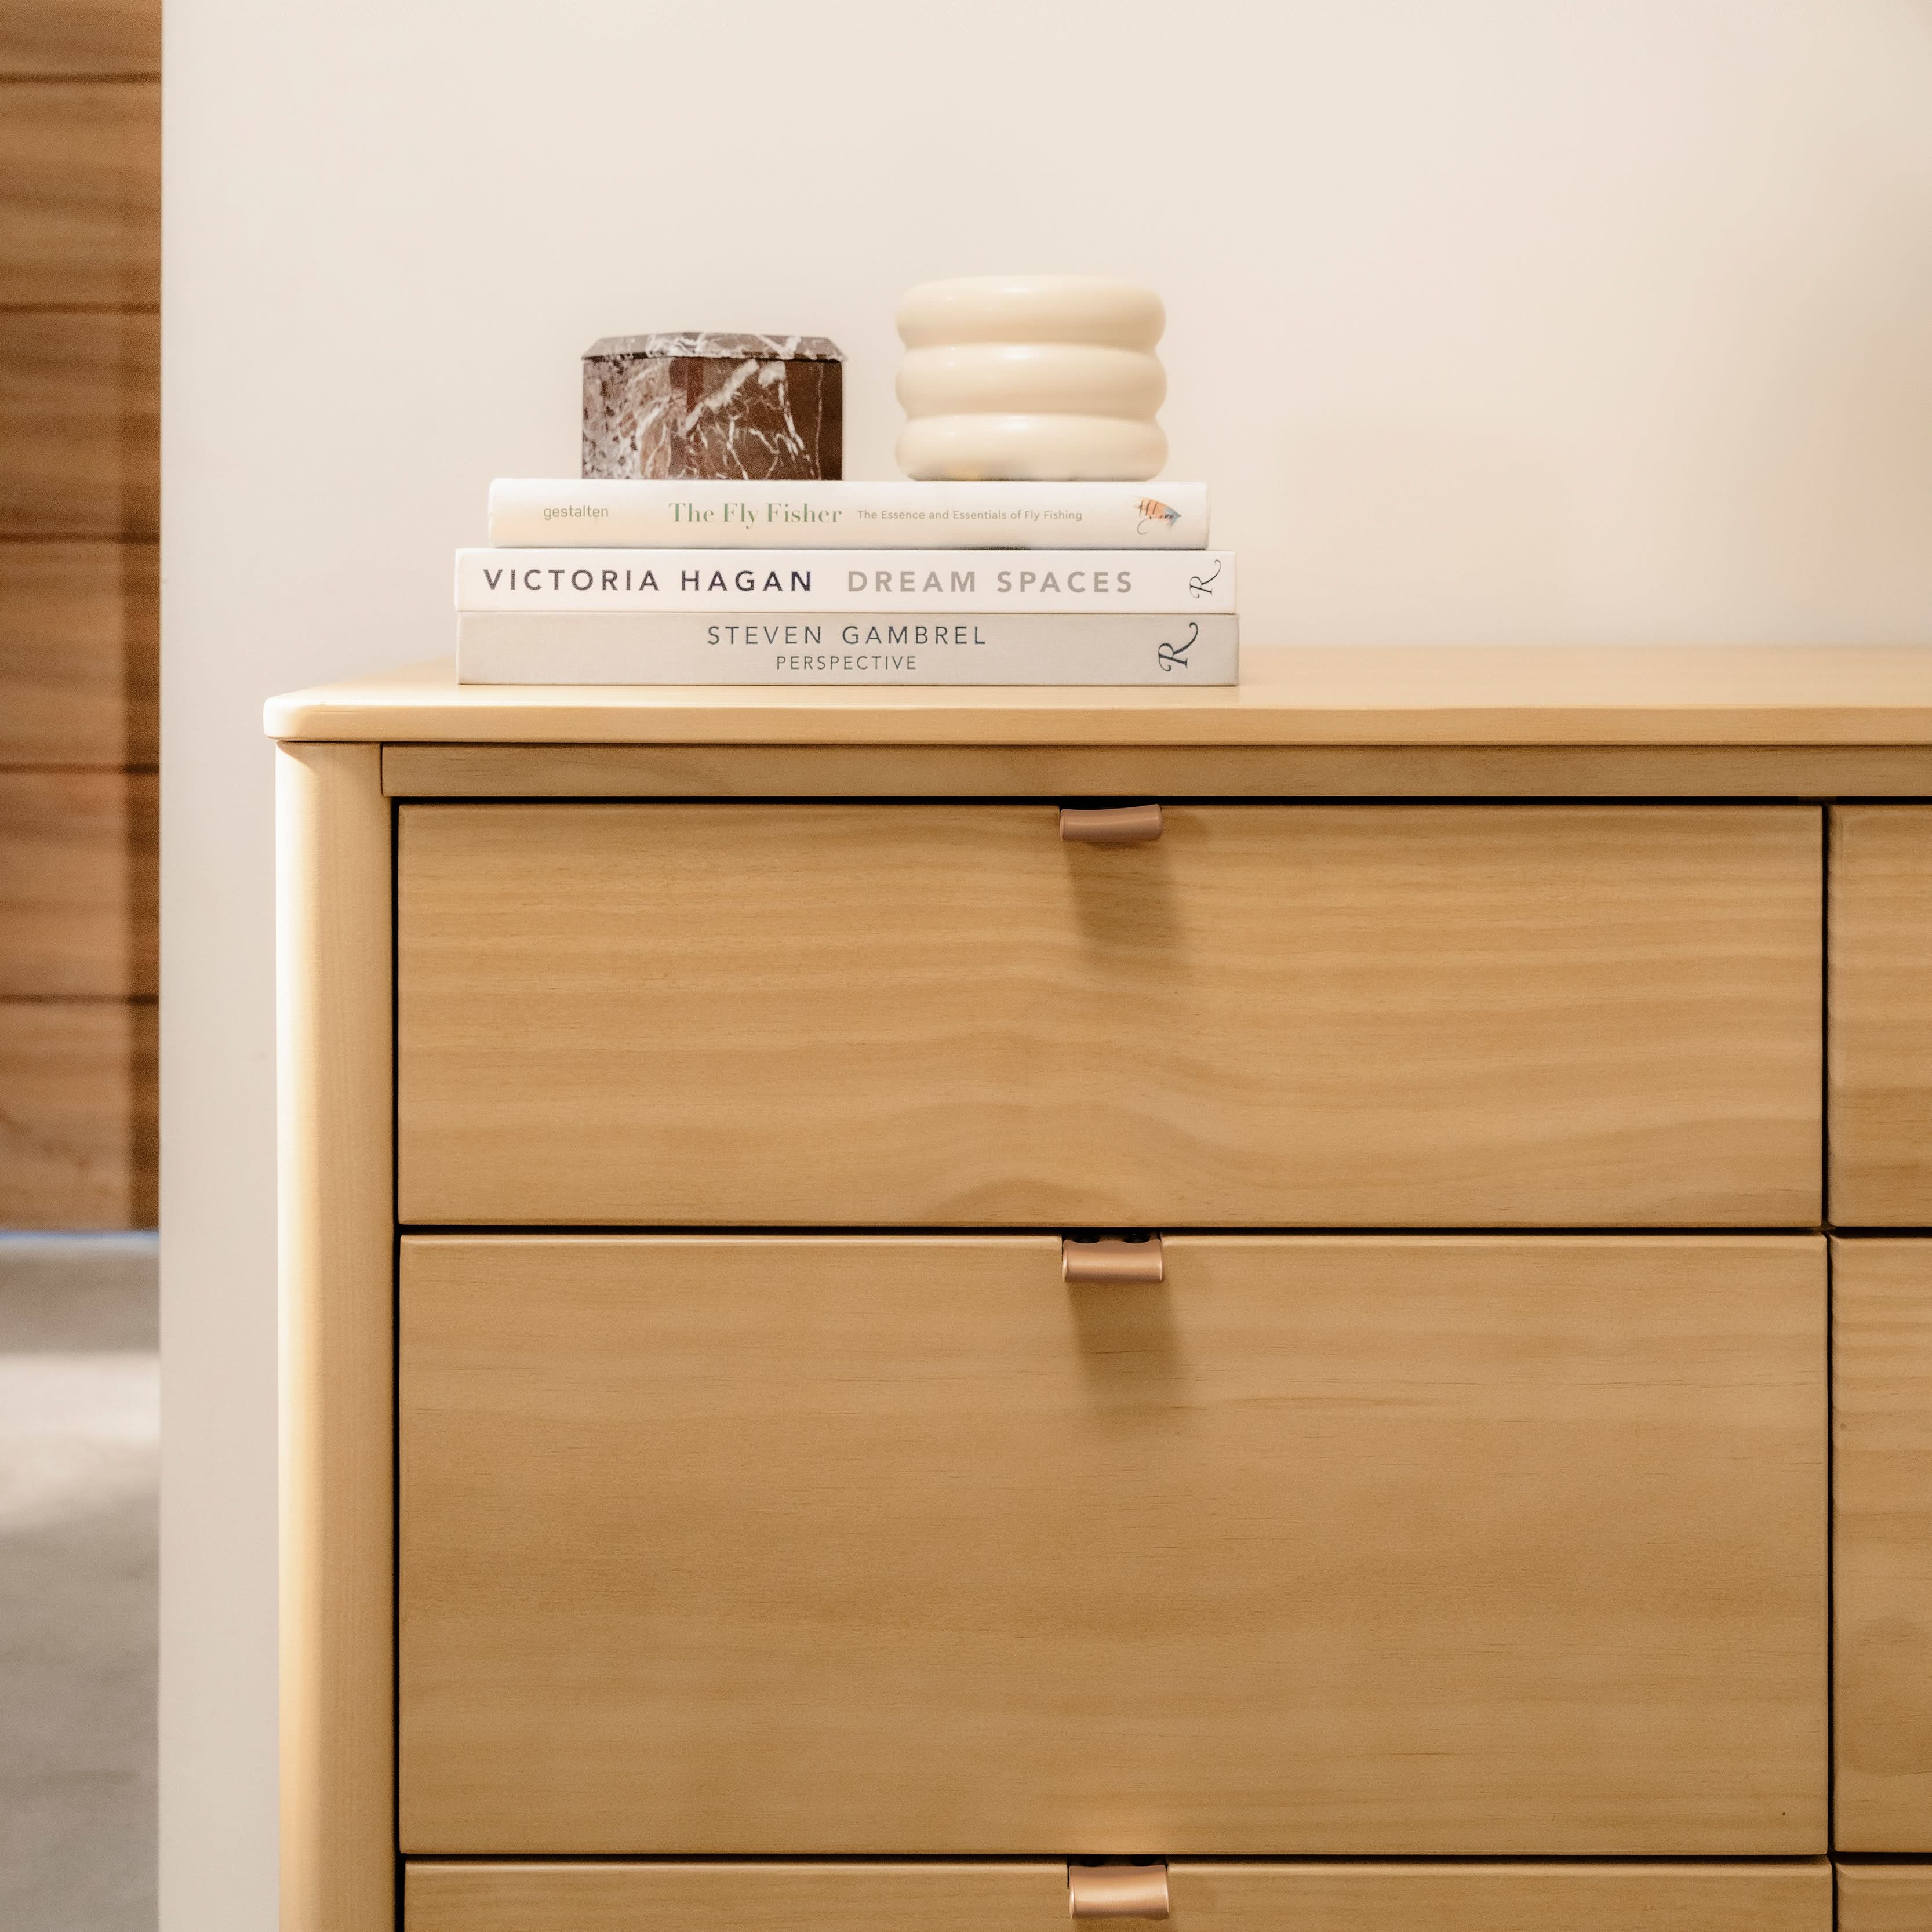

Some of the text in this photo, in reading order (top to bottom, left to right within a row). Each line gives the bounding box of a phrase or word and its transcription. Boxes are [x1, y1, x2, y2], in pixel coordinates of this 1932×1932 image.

[544, 505, 609, 521] gestalten
[668, 503, 842, 530] The Fly Fisher
[857, 510, 1082, 522] The Essence and Essentials of Fly Fishing
[483, 569, 1132, 594] VICTORIA HAGAN DREAM SPACES
[707, 625, 986, 645] STEVEN GAMBREL
[777, 655, 916, 670] PERSPECTIVE
